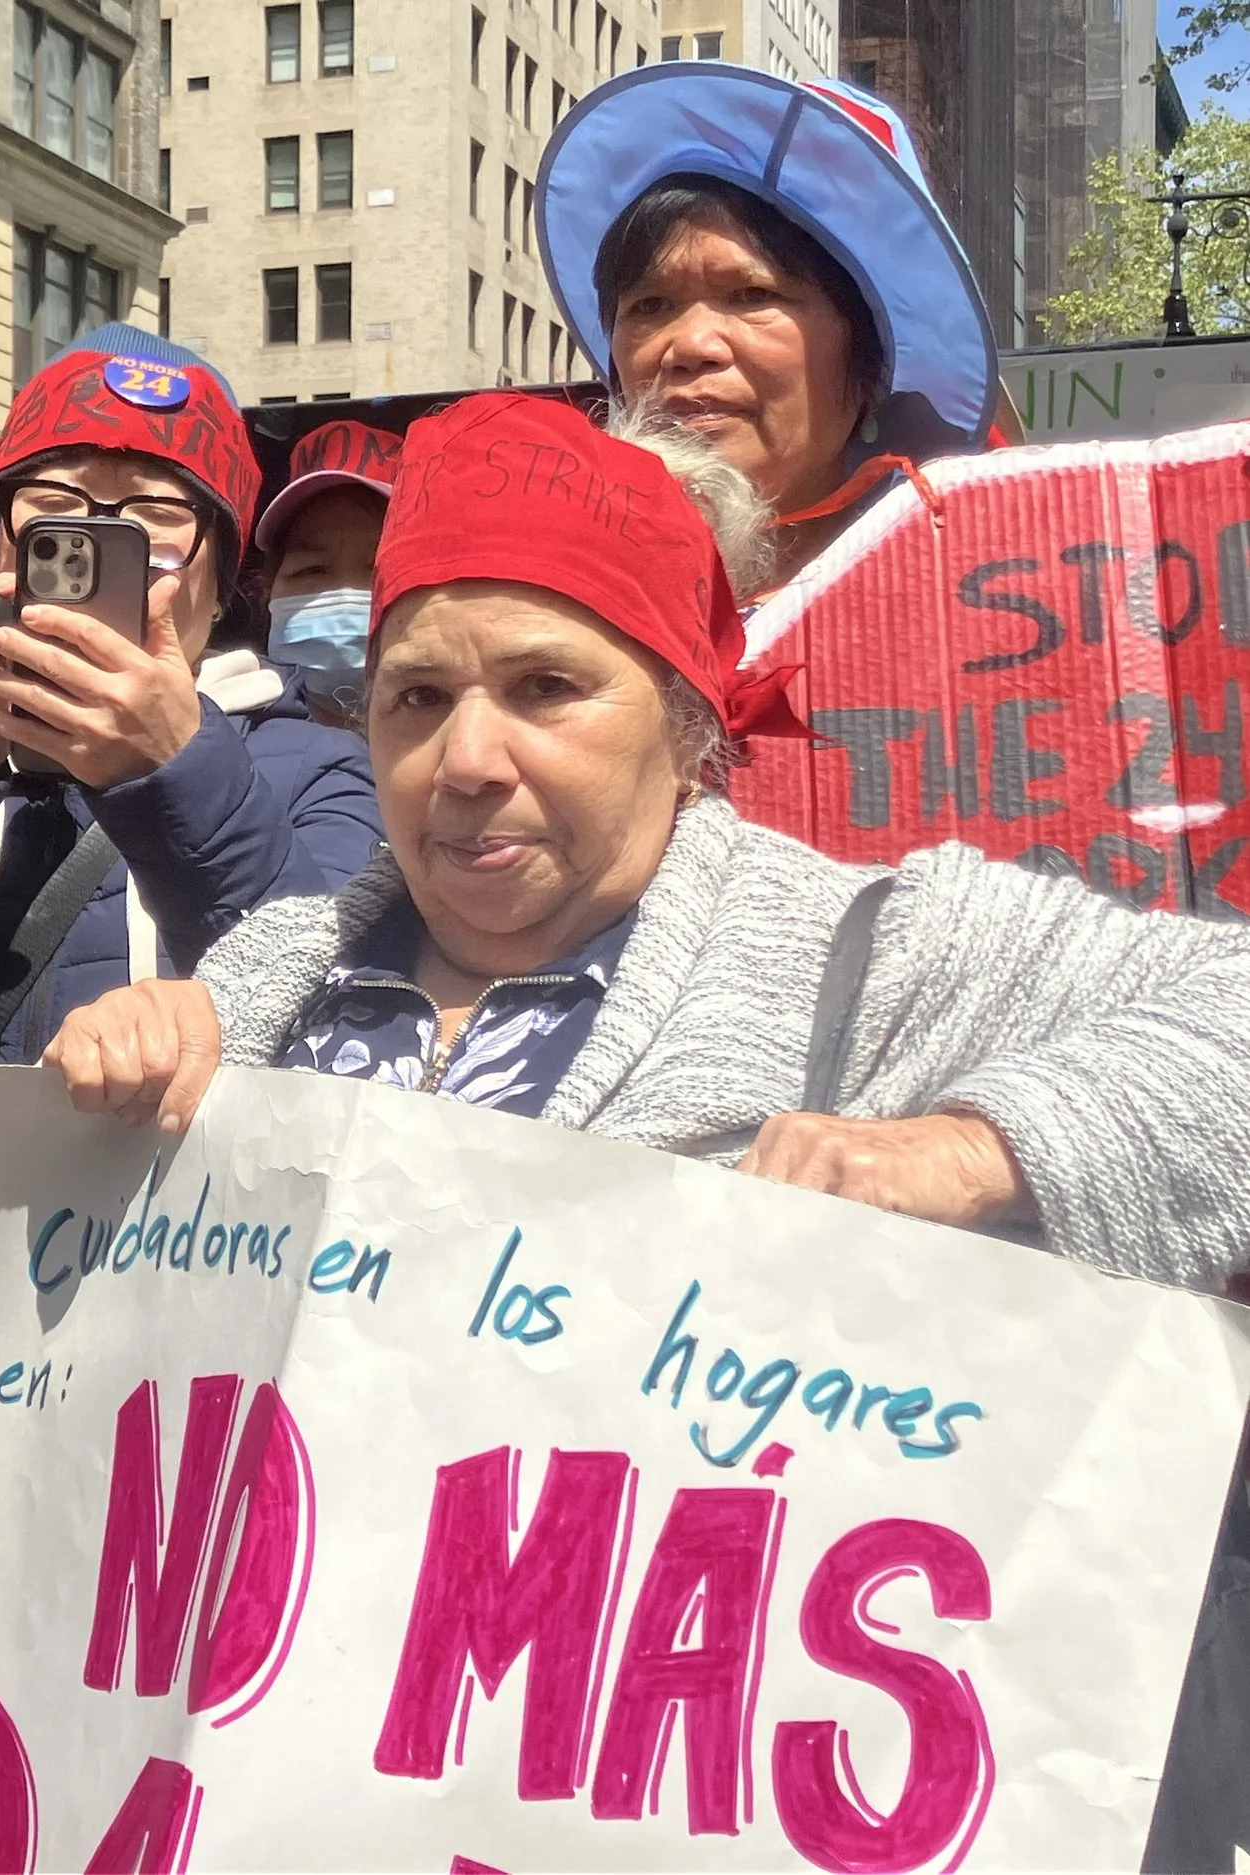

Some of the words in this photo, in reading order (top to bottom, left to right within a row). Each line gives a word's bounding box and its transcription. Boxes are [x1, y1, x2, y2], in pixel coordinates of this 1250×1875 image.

[110, 356, 137, 368] NO
[139, 361, 187, 380] MORE
[118, 369, 171, 397] 24
[474, 439, 651, 549] STRIKE
[810, 697, 1066, 830] THE
[307, 1236, 392, 1304] en
[467, 1226, 572, 1346] los
[641, 1279, 987, 1468] hogares
[83, 1373, 317, 1729] NO
[373, 1443, 997, 1875] MÁS
